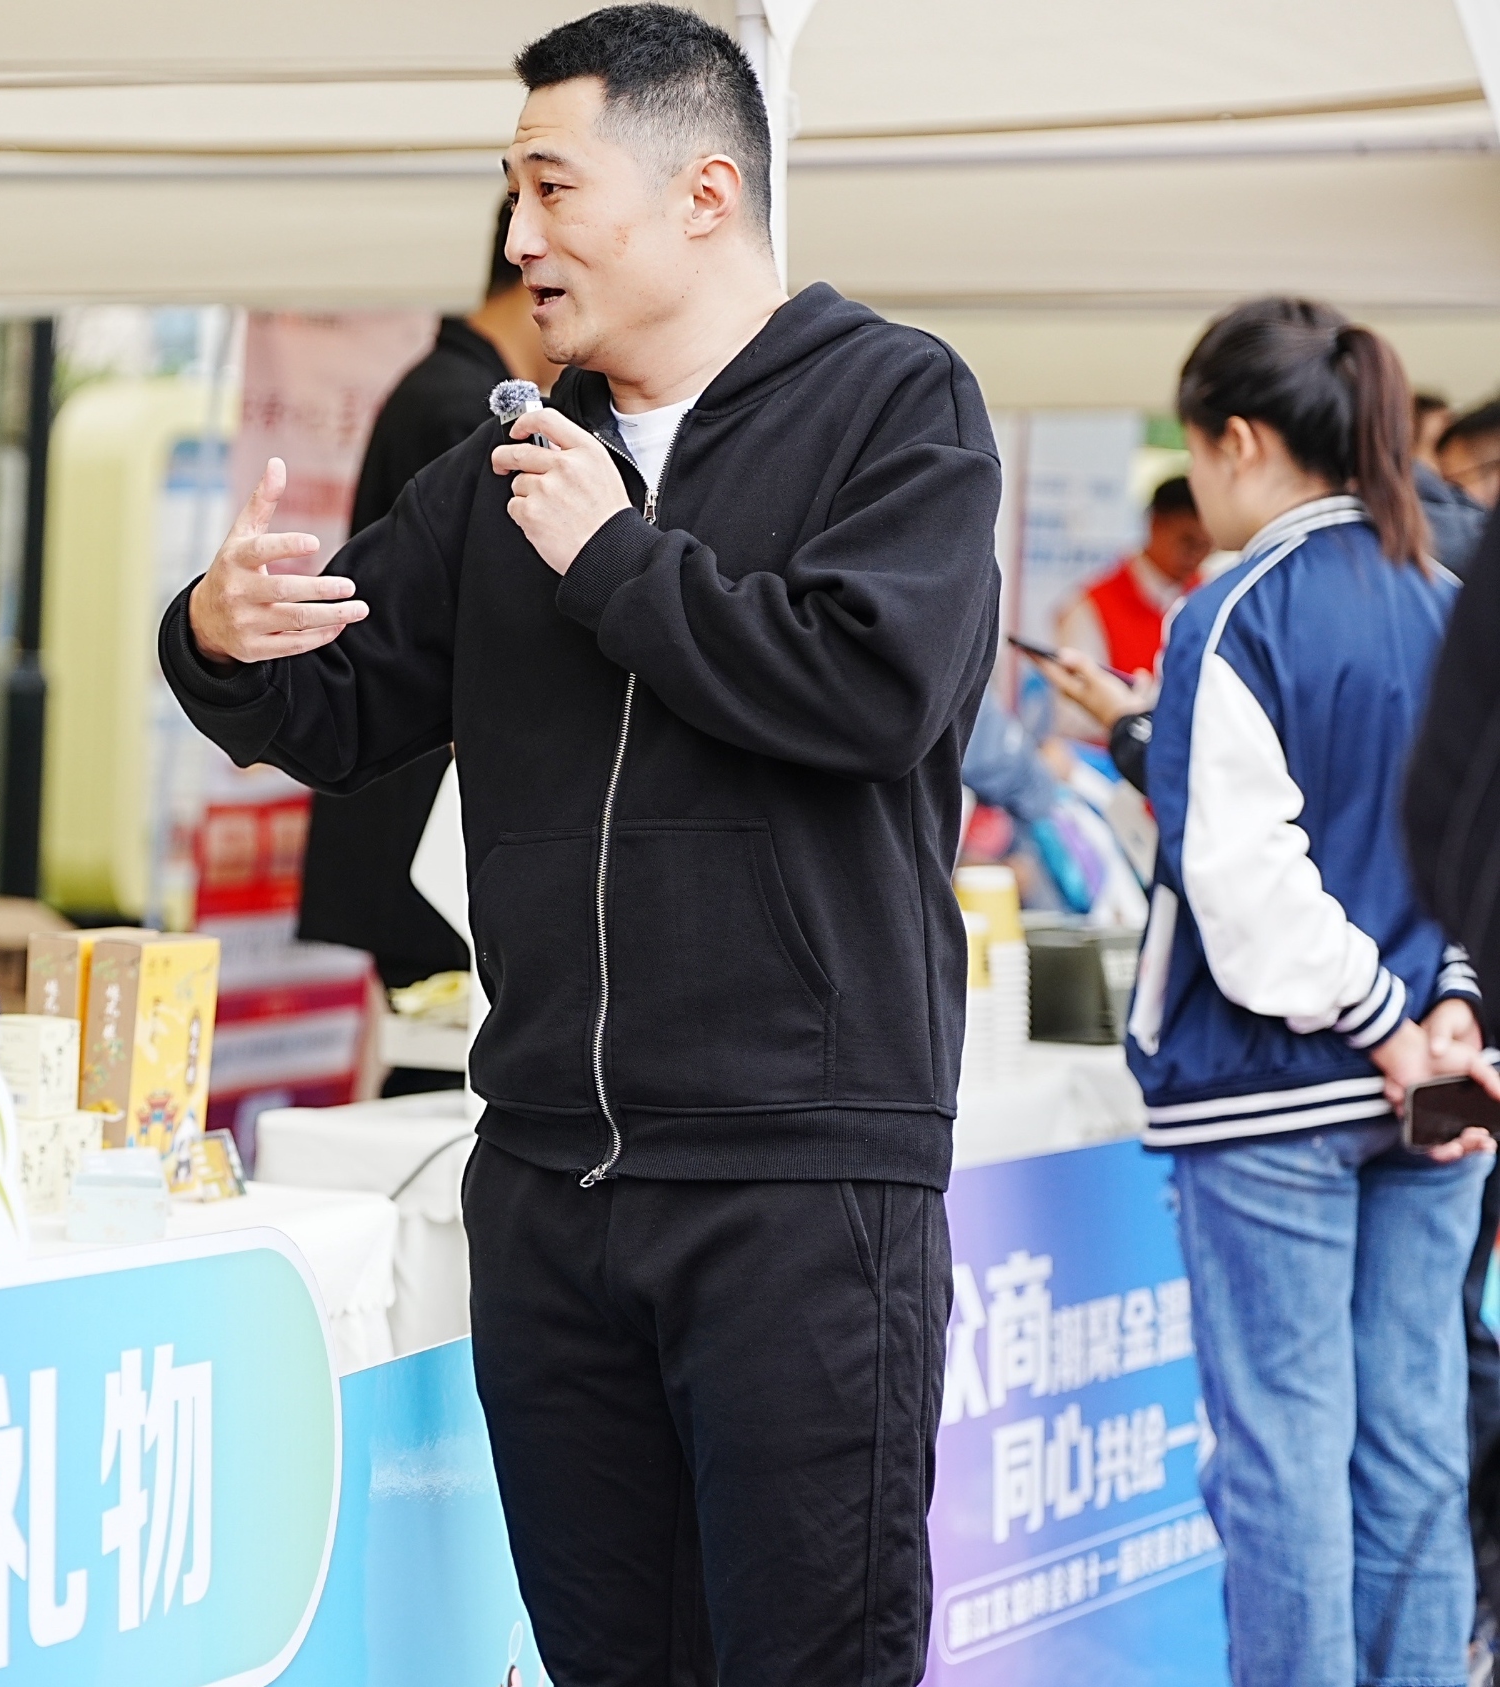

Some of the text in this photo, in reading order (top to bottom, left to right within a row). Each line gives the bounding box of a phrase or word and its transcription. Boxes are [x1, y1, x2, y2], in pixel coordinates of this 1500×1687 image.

[990, 1398, 1218, 1545] 同心共绘一
